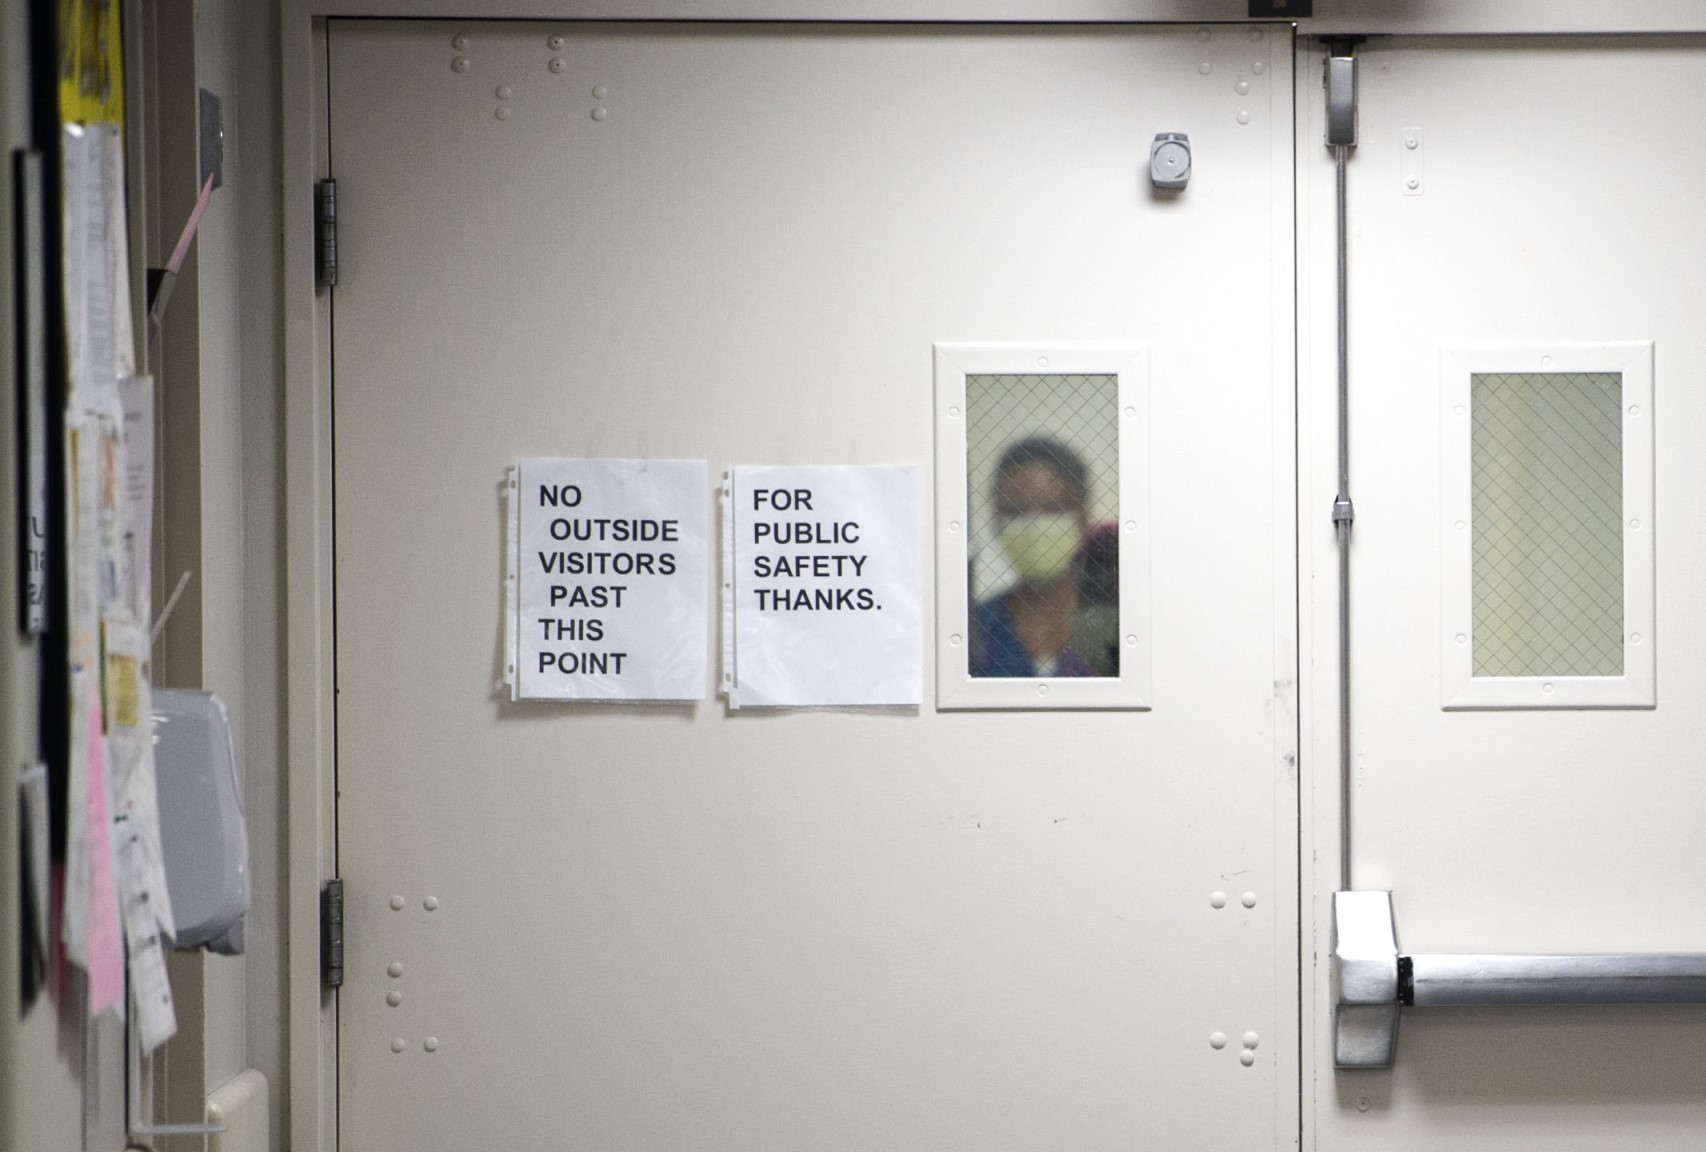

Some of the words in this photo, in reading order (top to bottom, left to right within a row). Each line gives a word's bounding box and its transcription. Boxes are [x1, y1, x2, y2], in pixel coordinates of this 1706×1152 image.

[539, 484, 582, 508] NO
[753, 489, 813, 511] FOR
[549, 518, 679, 542] OUTSIDE
[754, 522, 860, 545] PUBLIC
[538, 551, 676, 576] VISITORS
[754, 555, 867, 578] SAFETY
[550, 585, 628, 608] PAST
[753, 588, 882, 611] THANKS.
[537, 618, 604, 642] THIS
[539, 651, 627, 675] POINT
